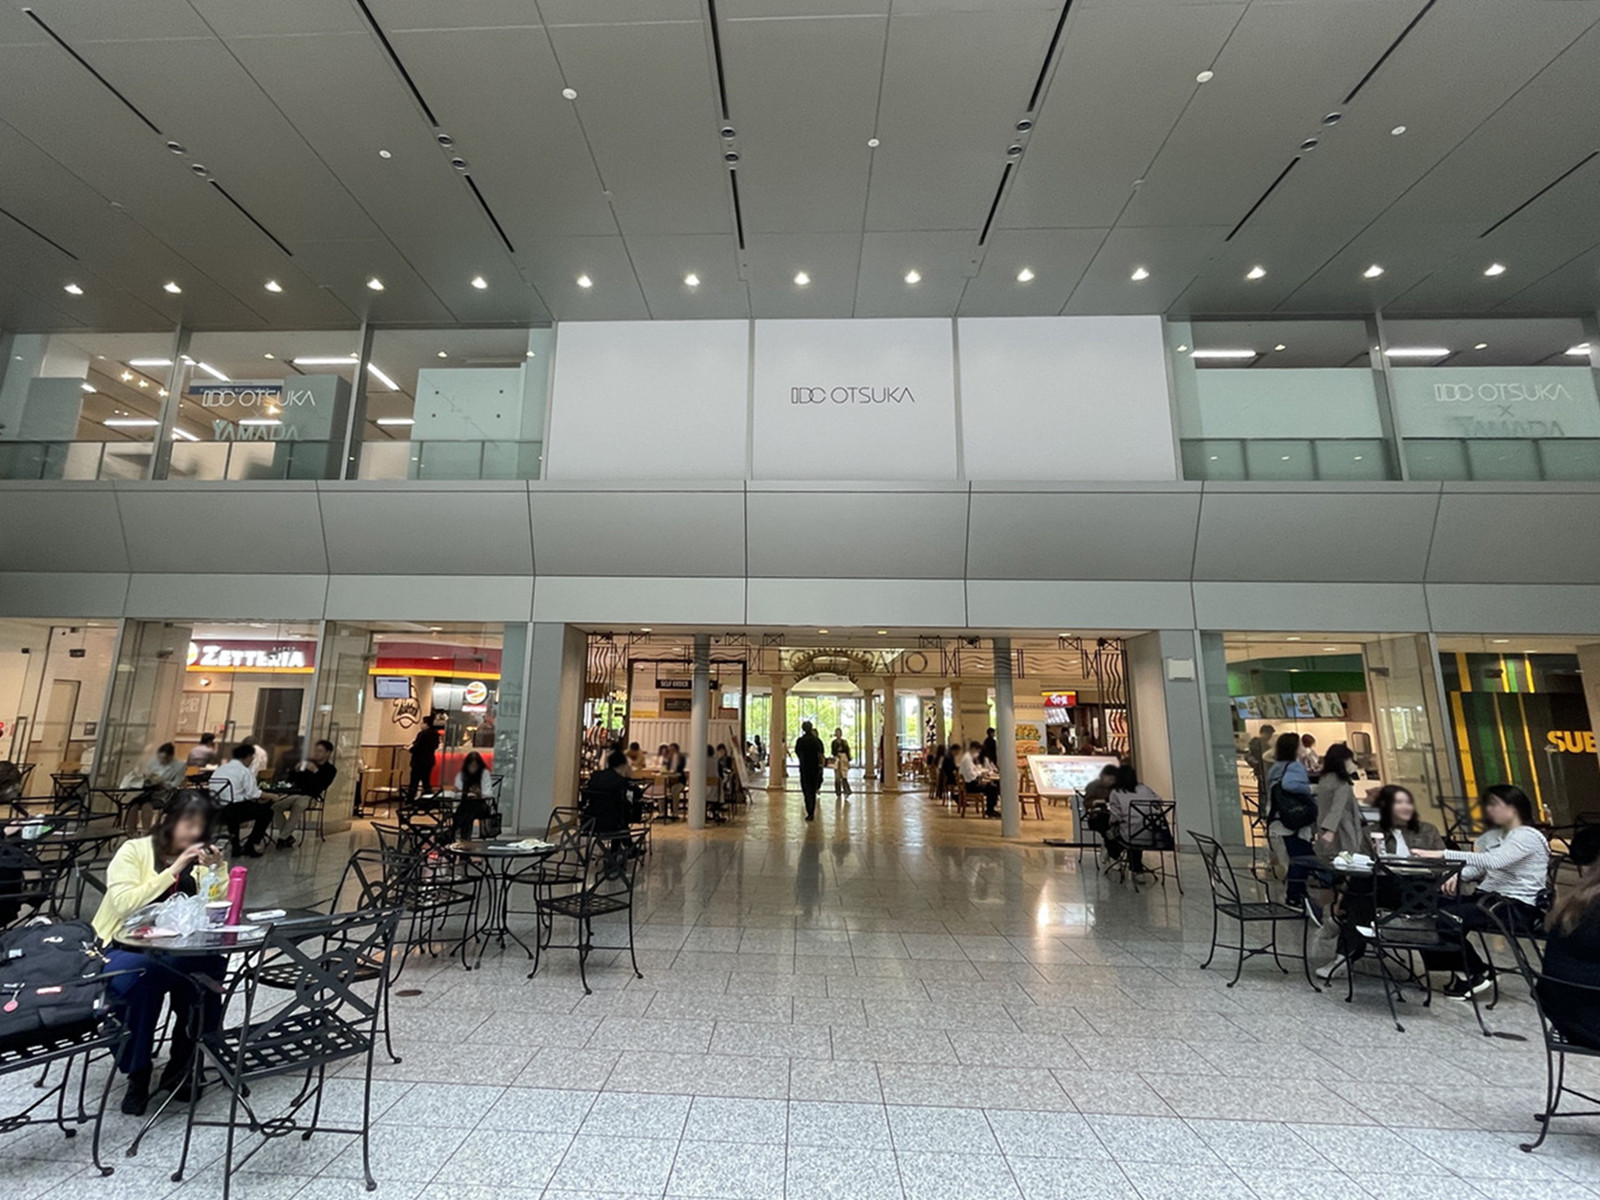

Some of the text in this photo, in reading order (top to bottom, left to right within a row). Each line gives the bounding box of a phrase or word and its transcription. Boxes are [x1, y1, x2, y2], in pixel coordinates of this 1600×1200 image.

[239, 390, 316, 407] OTSUKA
[791, 386, 915, 404] IDC OTSUKA
[1478, 383, 1573, 401] OTSUKA
[211, 420, 301, 441] YAMADA
[200, 645, 305, 668] ZETTERIA
